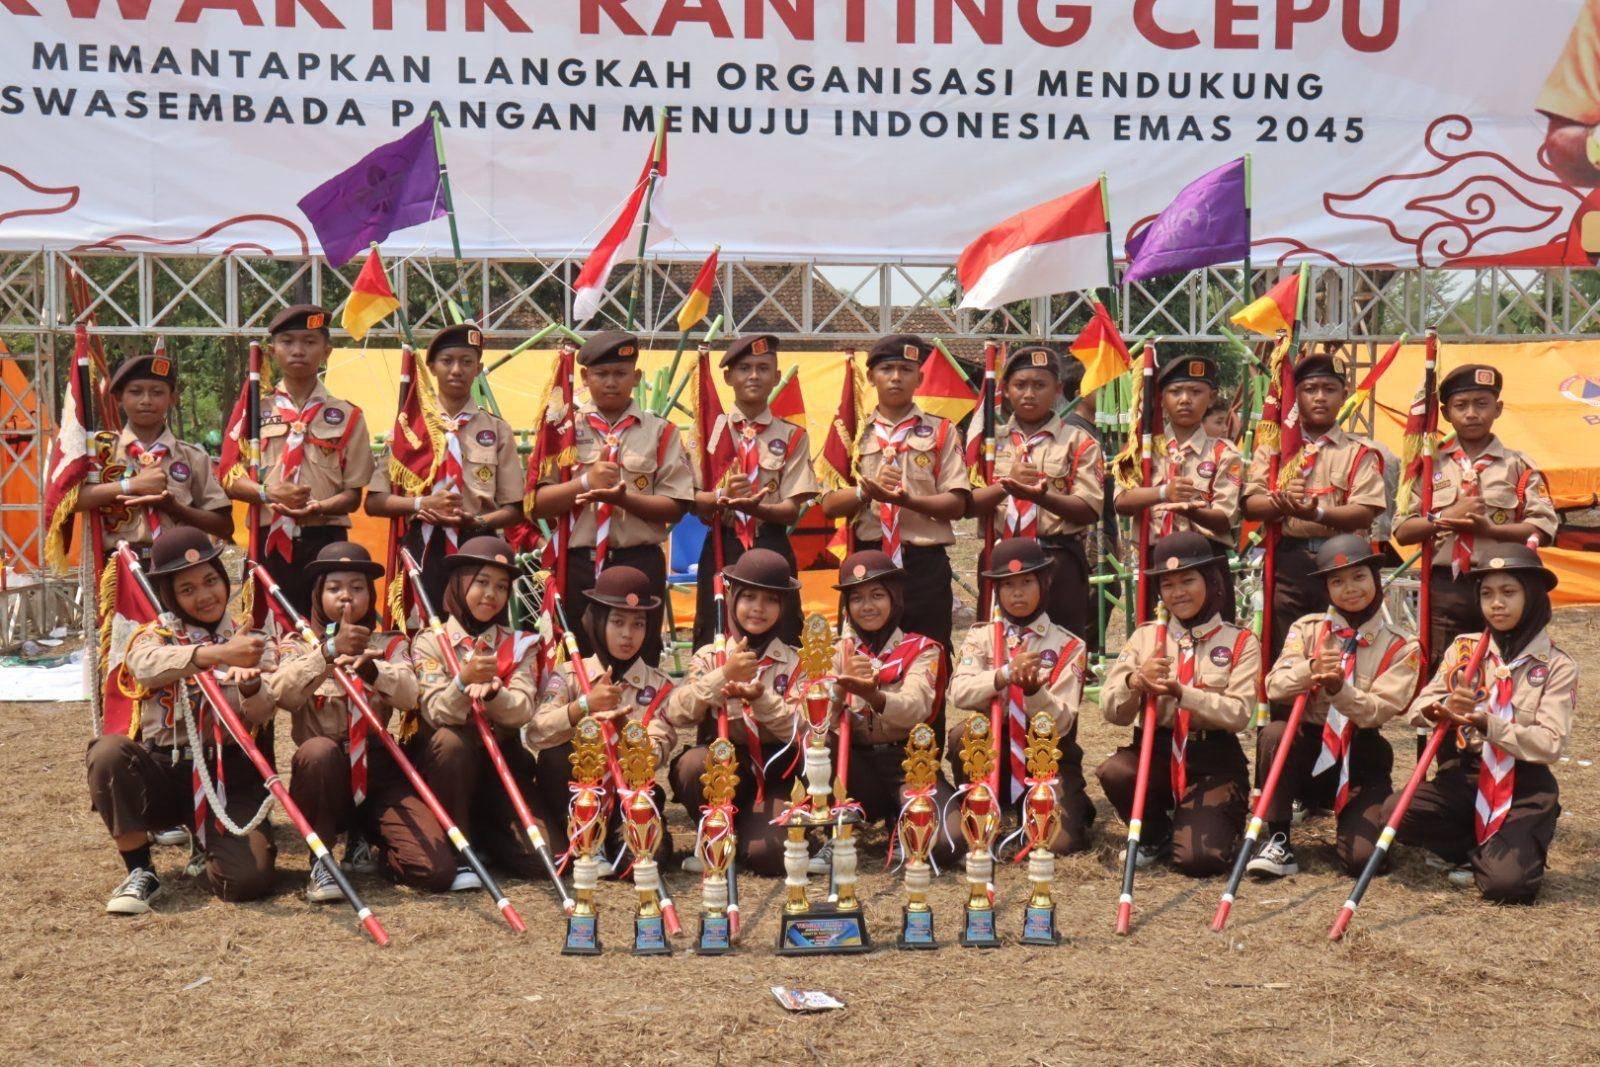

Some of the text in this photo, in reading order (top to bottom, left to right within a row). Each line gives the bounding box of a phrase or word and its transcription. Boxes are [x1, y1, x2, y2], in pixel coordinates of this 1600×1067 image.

[1133, 0, 1401, 52] CEPU
[32, 42, 1324, 101] MEMANTAPKAN LANGKAH ORGANISASI MENDUKUNG
[0, 85, 1364, 143] SWASEMBADA PANGAN MENUJU INDONESIA EMAS 2045
